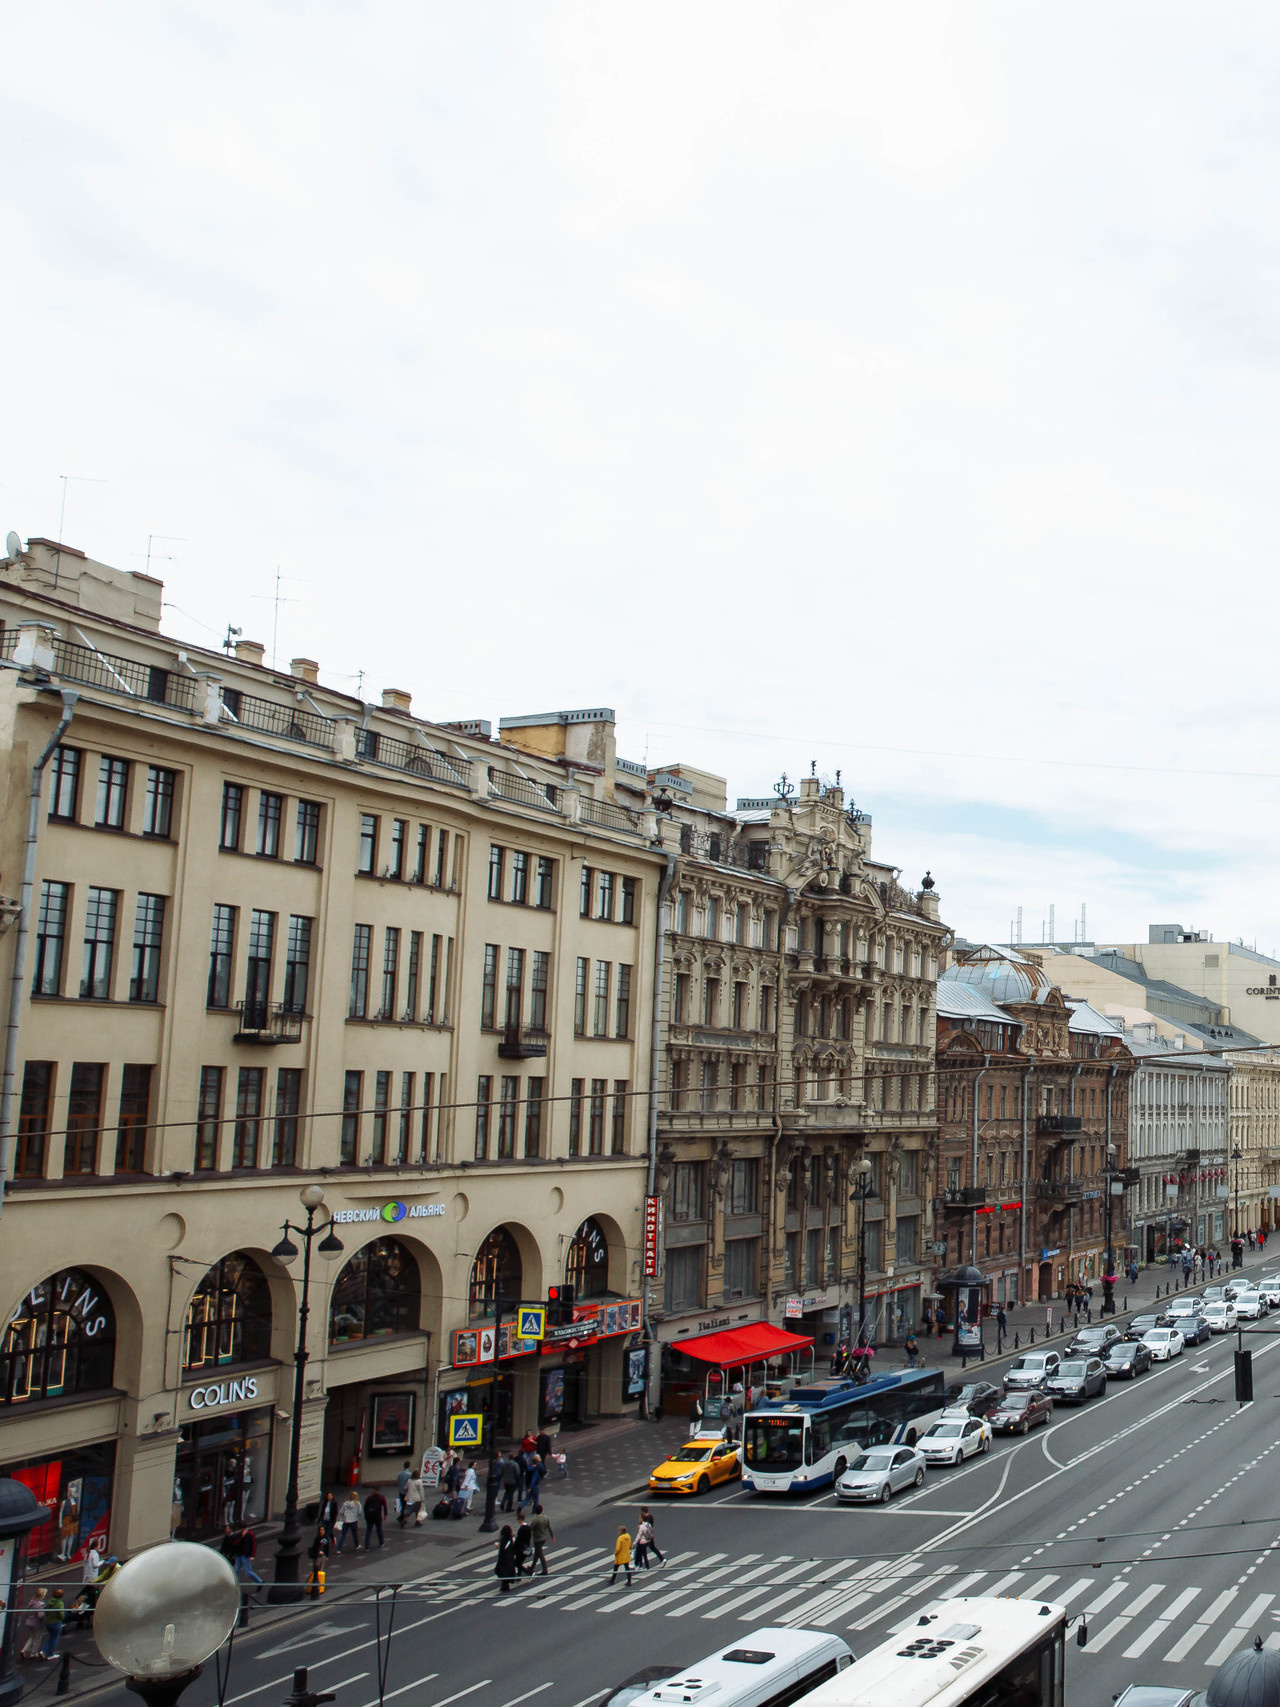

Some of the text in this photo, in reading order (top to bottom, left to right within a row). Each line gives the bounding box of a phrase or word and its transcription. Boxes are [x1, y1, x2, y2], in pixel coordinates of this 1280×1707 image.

[333, 1203, 446, 1223] НЕВСКИЙ АЛЬЯНС
[646, 1198, 657, 1275] КИНОТЕАТР
[190, 1376, 258, 1409] COLIN'S
